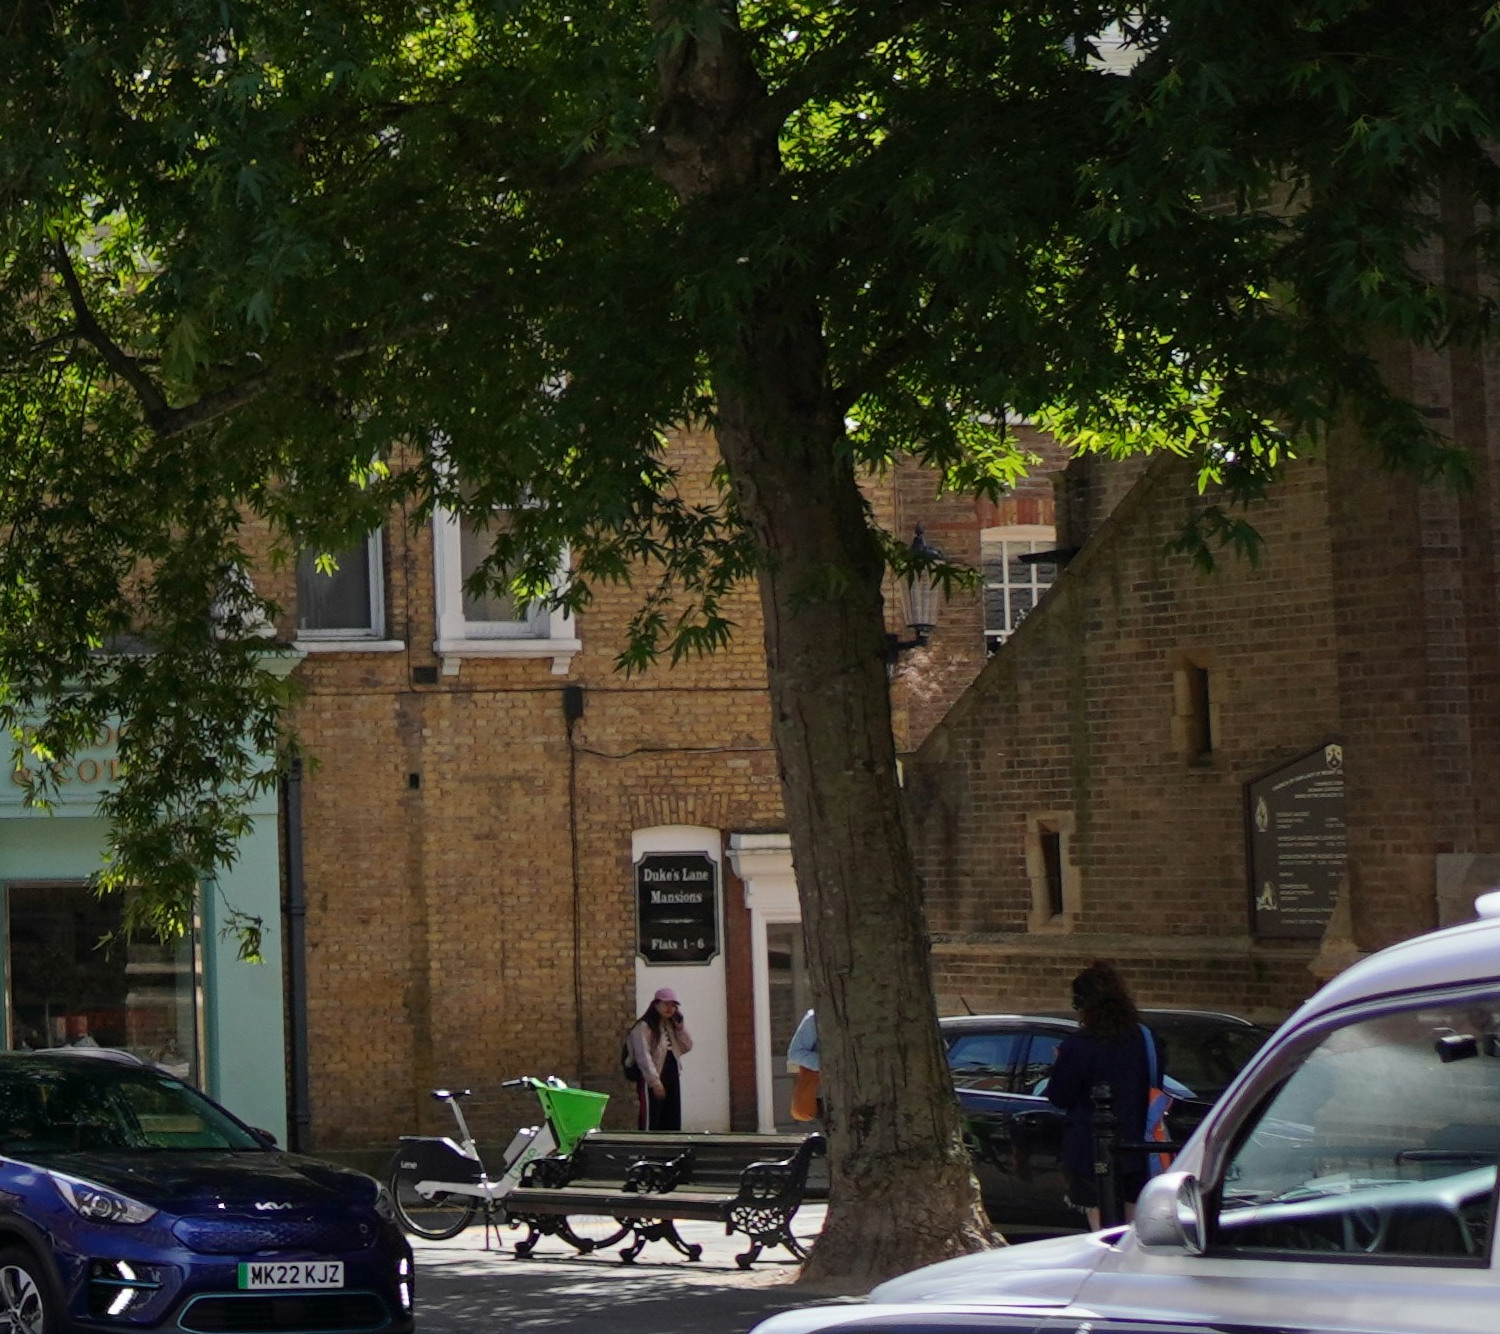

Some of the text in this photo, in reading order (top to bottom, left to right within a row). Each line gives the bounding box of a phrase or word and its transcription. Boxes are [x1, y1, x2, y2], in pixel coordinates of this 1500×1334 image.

[643, 868, 709, 882] Duke's Lane
[651, 890, 703, 904] Mansions
[651, 938, 678, 950] Flats
[251, 1264, 340, 1285] MK22 KJZ
